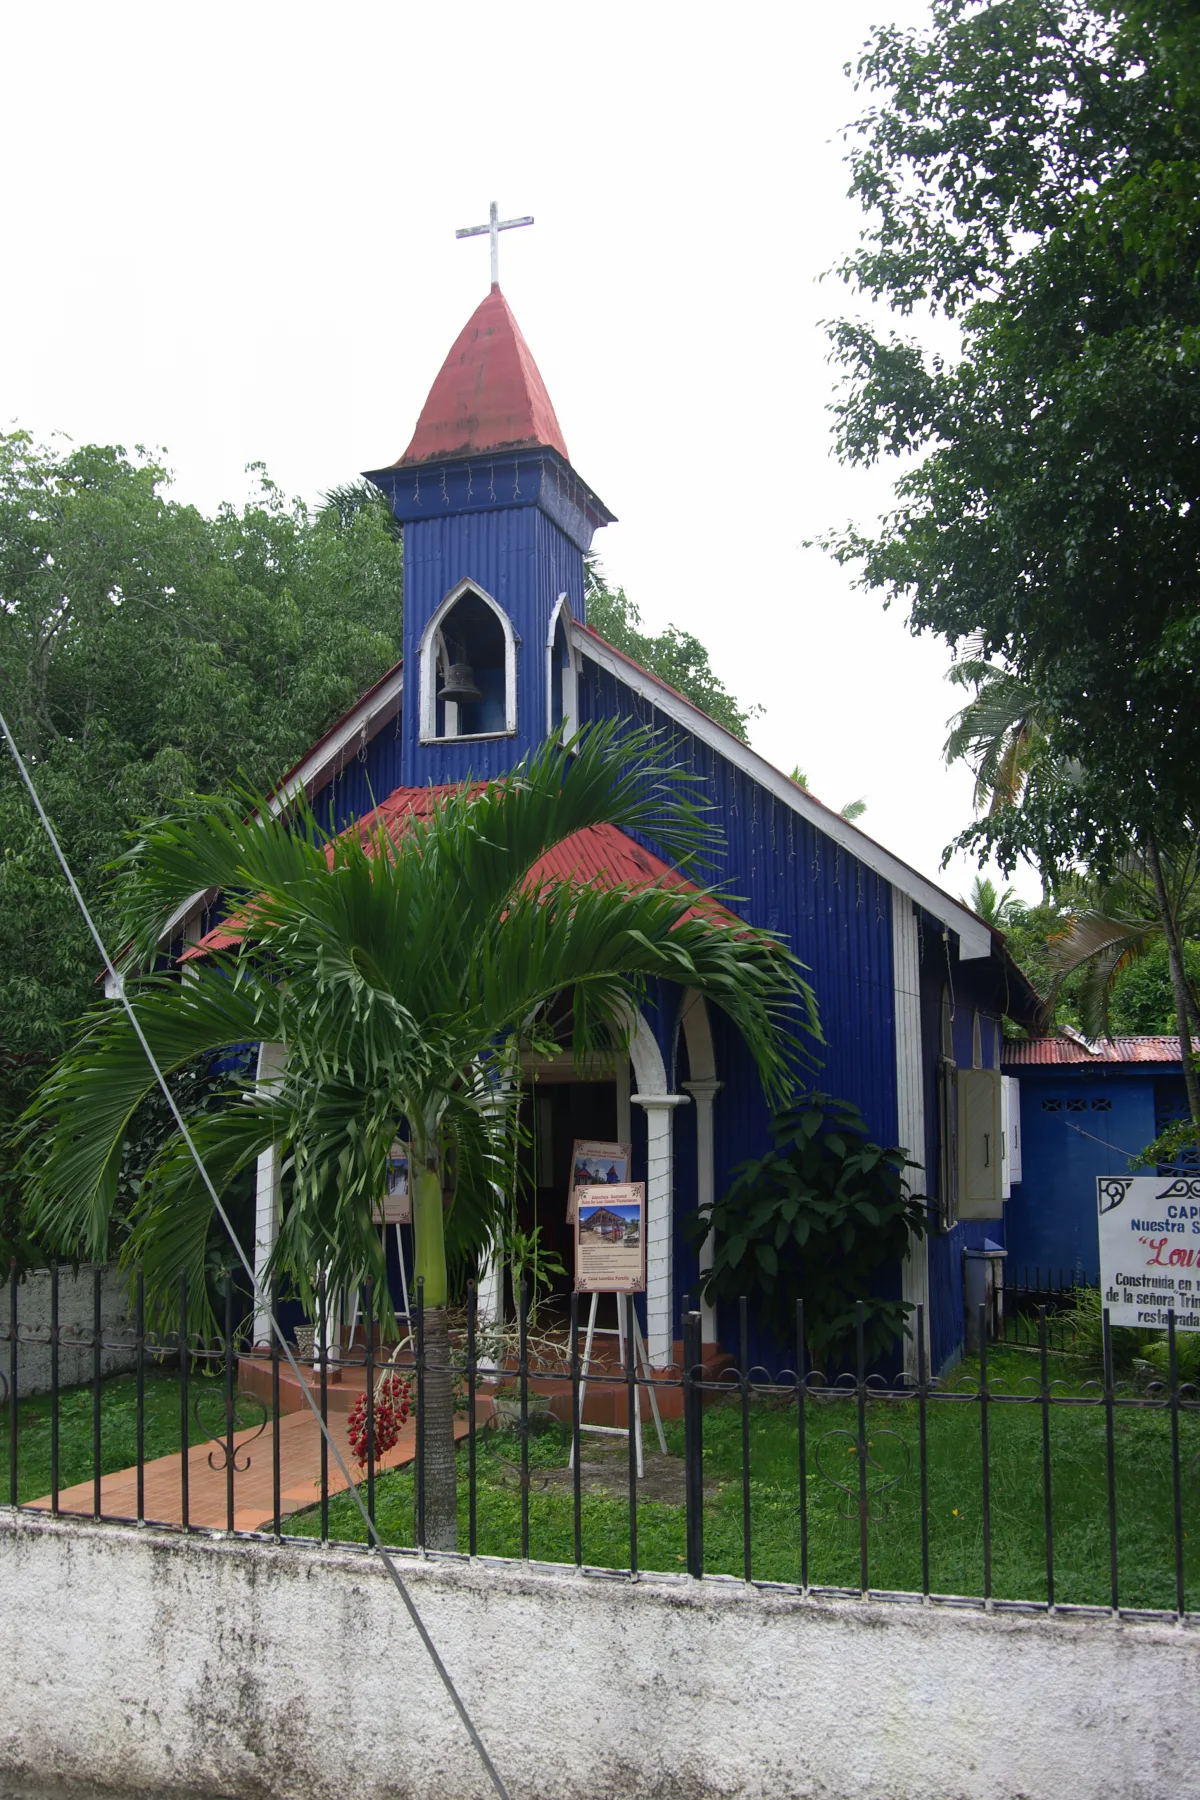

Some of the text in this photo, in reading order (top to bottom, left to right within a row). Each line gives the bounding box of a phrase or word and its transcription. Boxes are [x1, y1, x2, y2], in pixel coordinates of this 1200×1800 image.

[1131, 1218, 1185, 1233] Nuestra
[1115, 1272, 1174, 1289] Construida
[1178, 1279, 1192, 1291] en
[1106, 1286, 1119, 1302] de
[1123, 1287, 1133, 1303] la
[1136, 1292, 1174, 1306] señora
[1137, 1308, 1200, 1327] restarada
